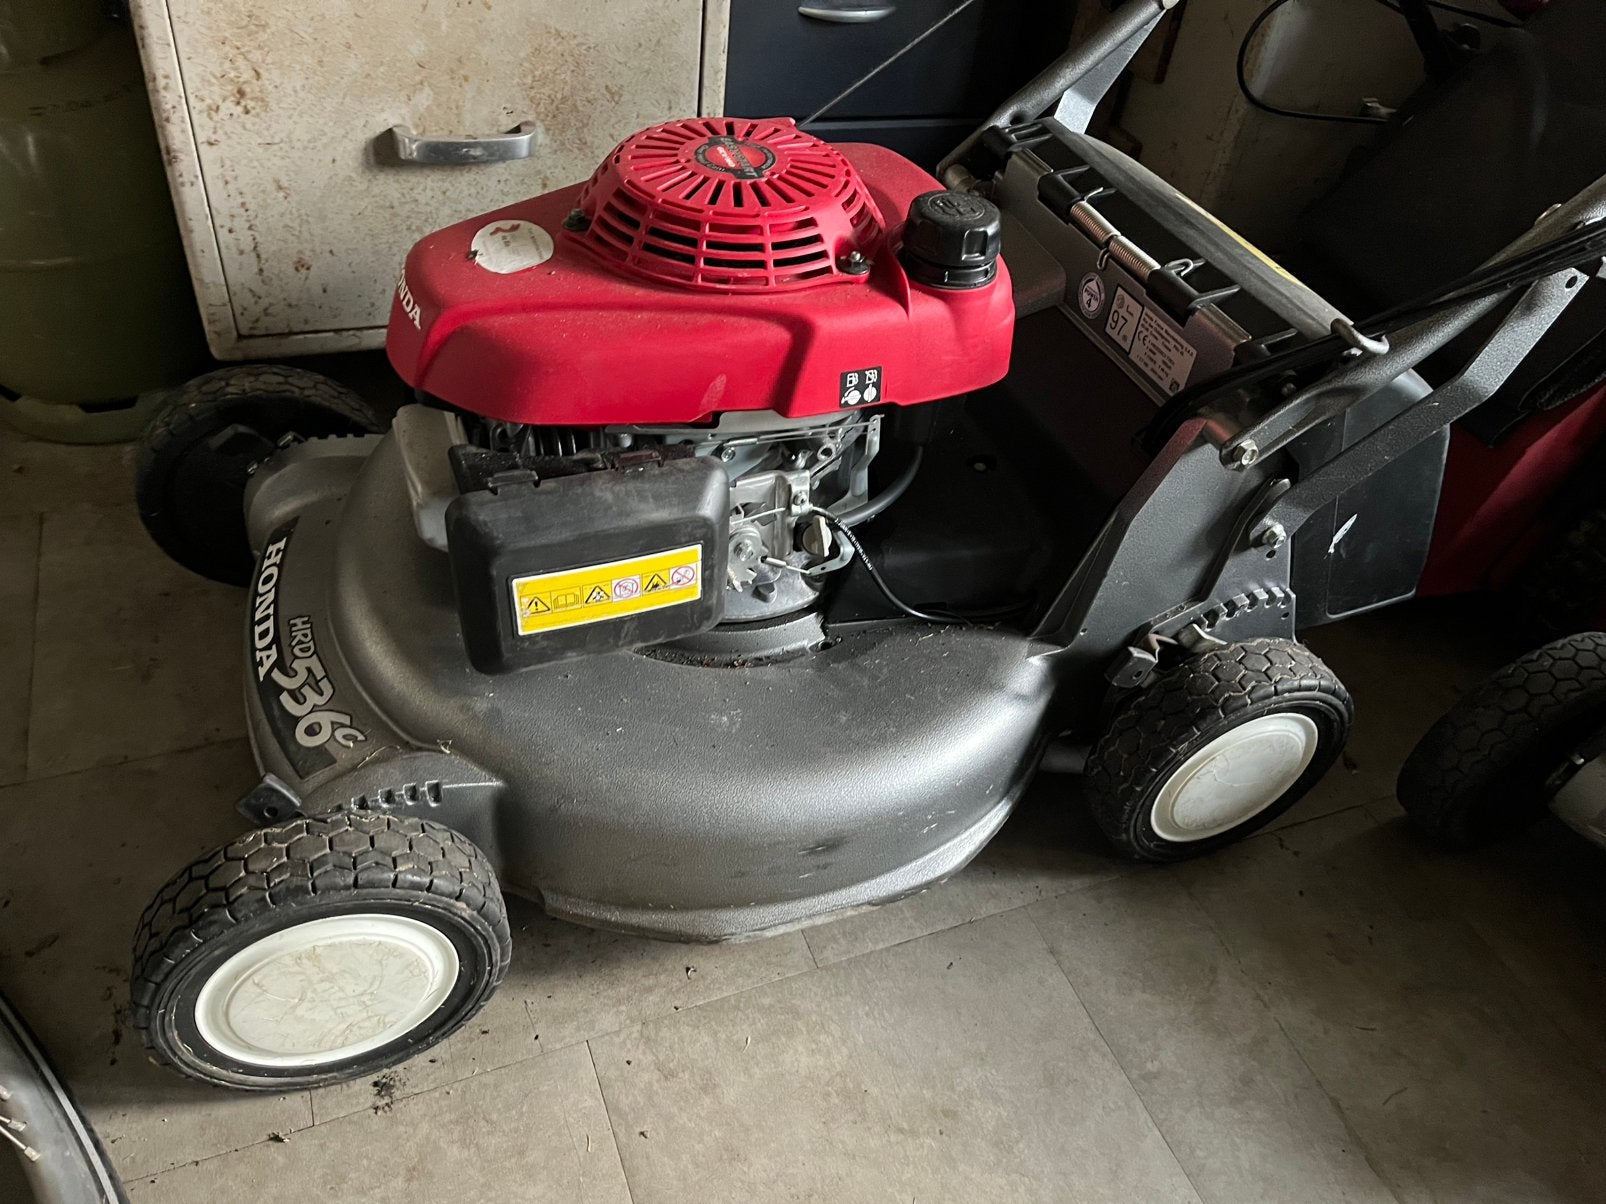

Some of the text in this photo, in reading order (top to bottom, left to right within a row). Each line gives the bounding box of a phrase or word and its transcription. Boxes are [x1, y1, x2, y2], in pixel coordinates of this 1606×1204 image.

[398, 268, 422, 331] NDA
[1110, 310, 1128, 336] 97
[254, 537, 287, 682] HONDA
